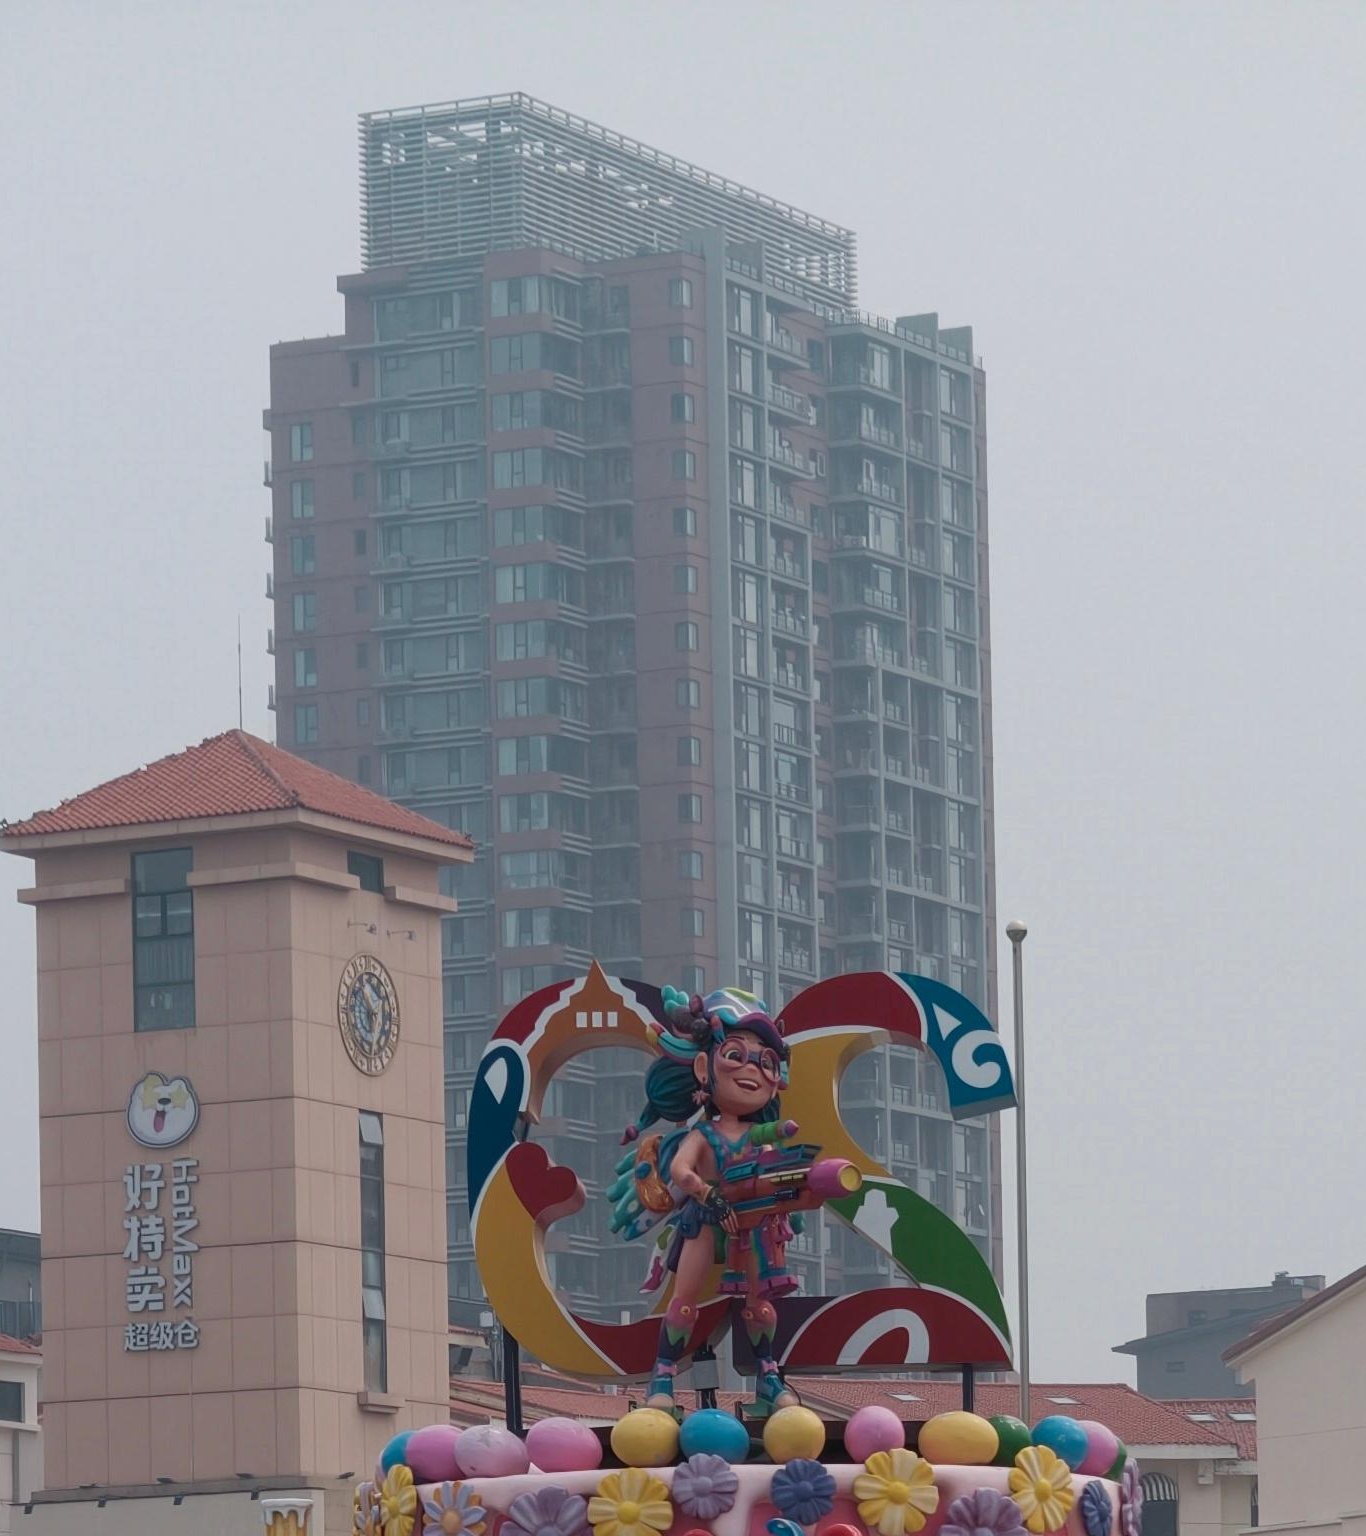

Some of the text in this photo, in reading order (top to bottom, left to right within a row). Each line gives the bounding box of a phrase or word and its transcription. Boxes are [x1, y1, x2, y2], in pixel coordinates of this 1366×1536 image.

[123, 1164, 165, 1312] 好特卖
[124, 1319, 199, 1351] 超级仓
